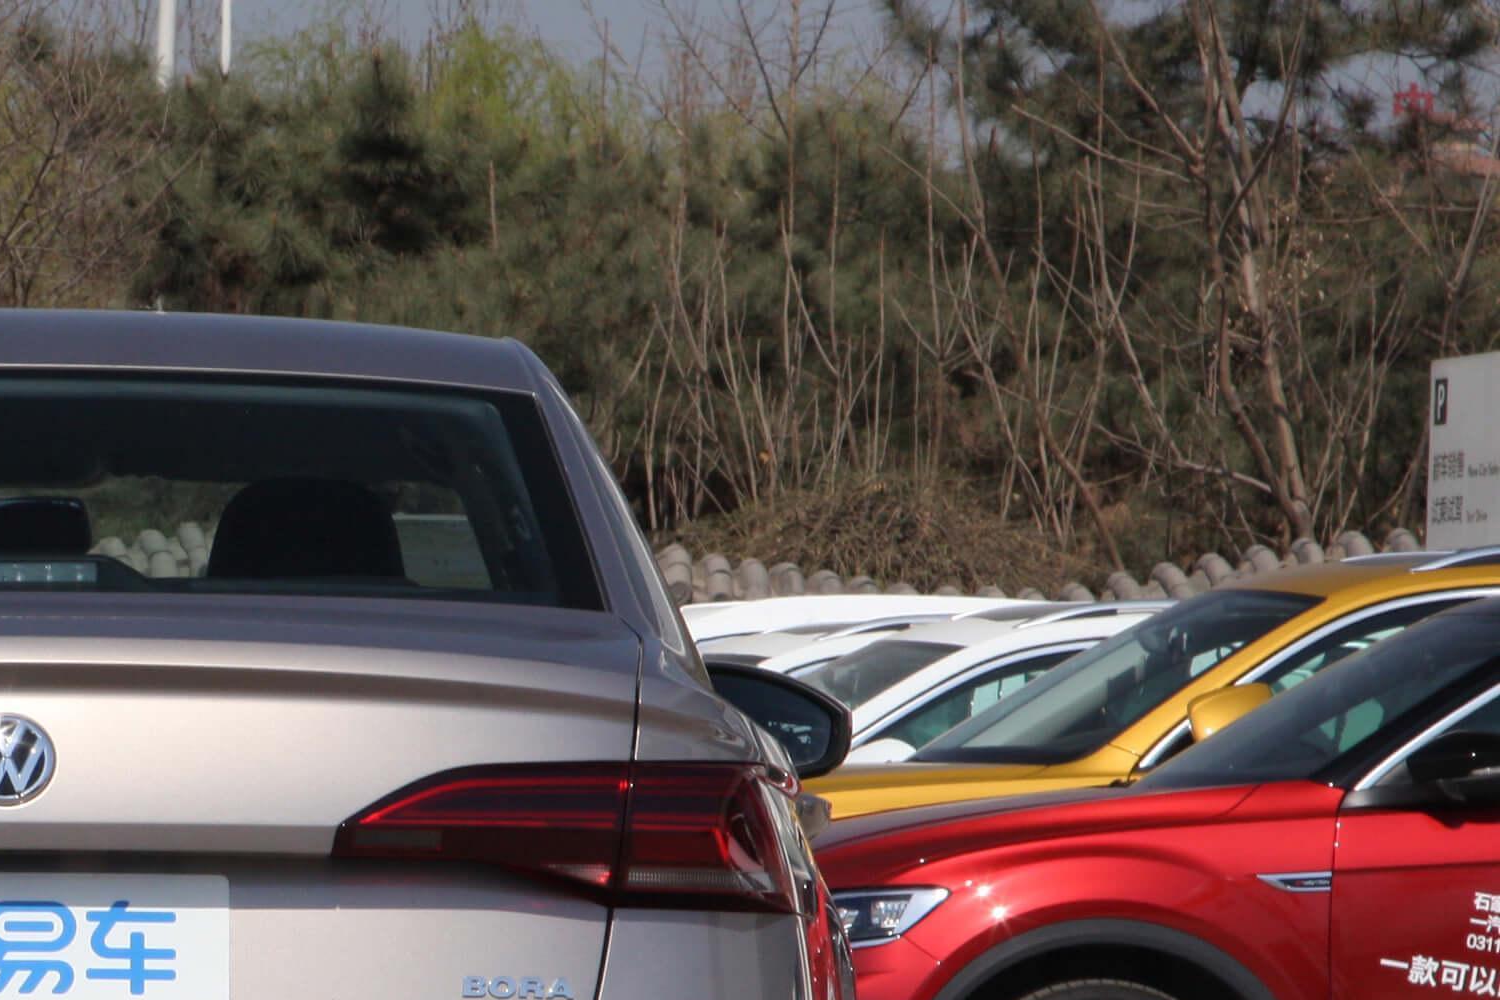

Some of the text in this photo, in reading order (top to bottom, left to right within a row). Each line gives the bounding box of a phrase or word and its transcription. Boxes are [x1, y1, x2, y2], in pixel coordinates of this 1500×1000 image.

[461, 974, 575, 1000] BORA
[1380, 954, 1500, 998] 一款可以
